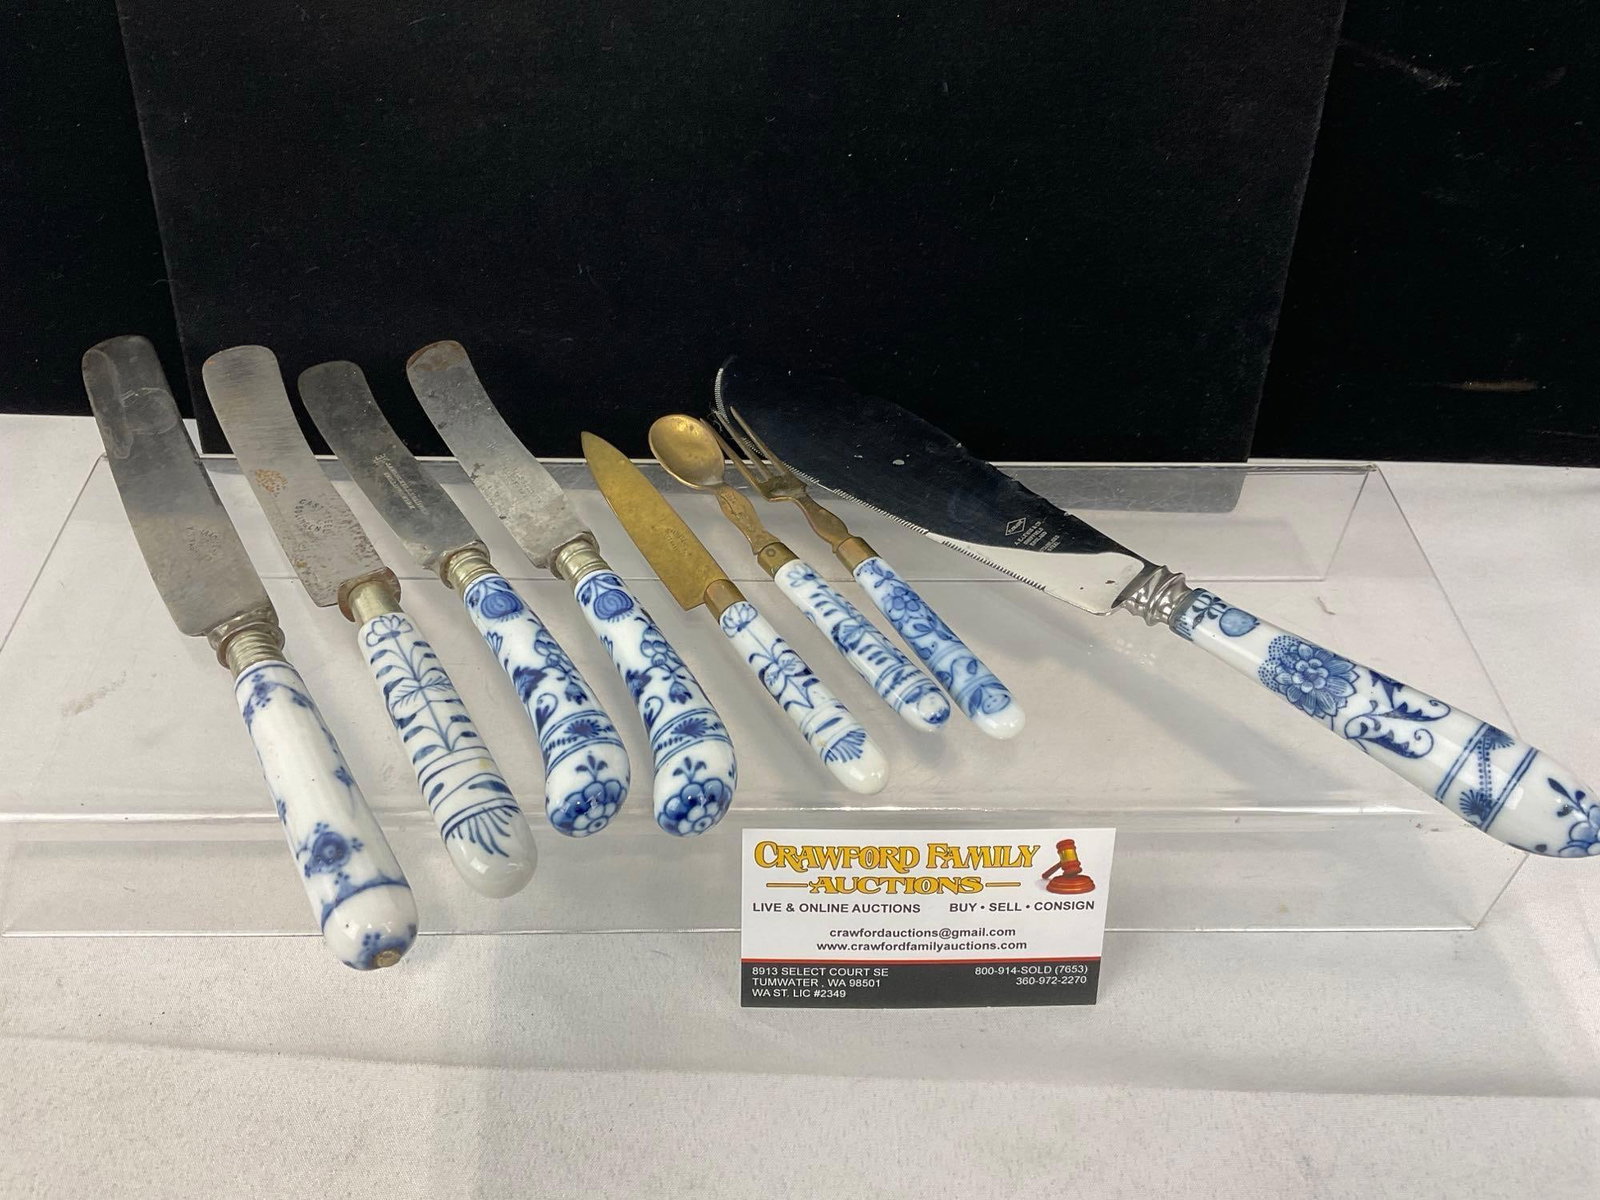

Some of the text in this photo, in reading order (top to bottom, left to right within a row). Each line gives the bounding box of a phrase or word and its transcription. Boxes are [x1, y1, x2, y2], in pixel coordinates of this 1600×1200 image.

[754, 840, 1041, 874] CRAWFORD FAMILY
[808, 876, 984, 895] AUCTIONS
[752, 902, 921, 914] LIVE & ONLINE AUCTIONS
[950, 900, 1095, 912] BUY SELL CONSIGN
[830, 927, 1016, 939] crawfordauctions@gmail.com
[817, 941, 1028, 953] www.crawfordfamilyauctions.com
[752, 967, 889, 977] 8913 SELECT COURT SE
[975, 964, 1088, 976] 800-914-SOLD (7653)
[752, 978, 819, 987] TUMWATER
[827, 978, 847, 987] WA
[849, 979, 881, 988] 98501
[1016, 975, 1087, 985] 360-972-2270
[751, 988, 771, 998] WA
[793, 989, 811, 998] LIC
[813, 989, 847, 998] #2349
